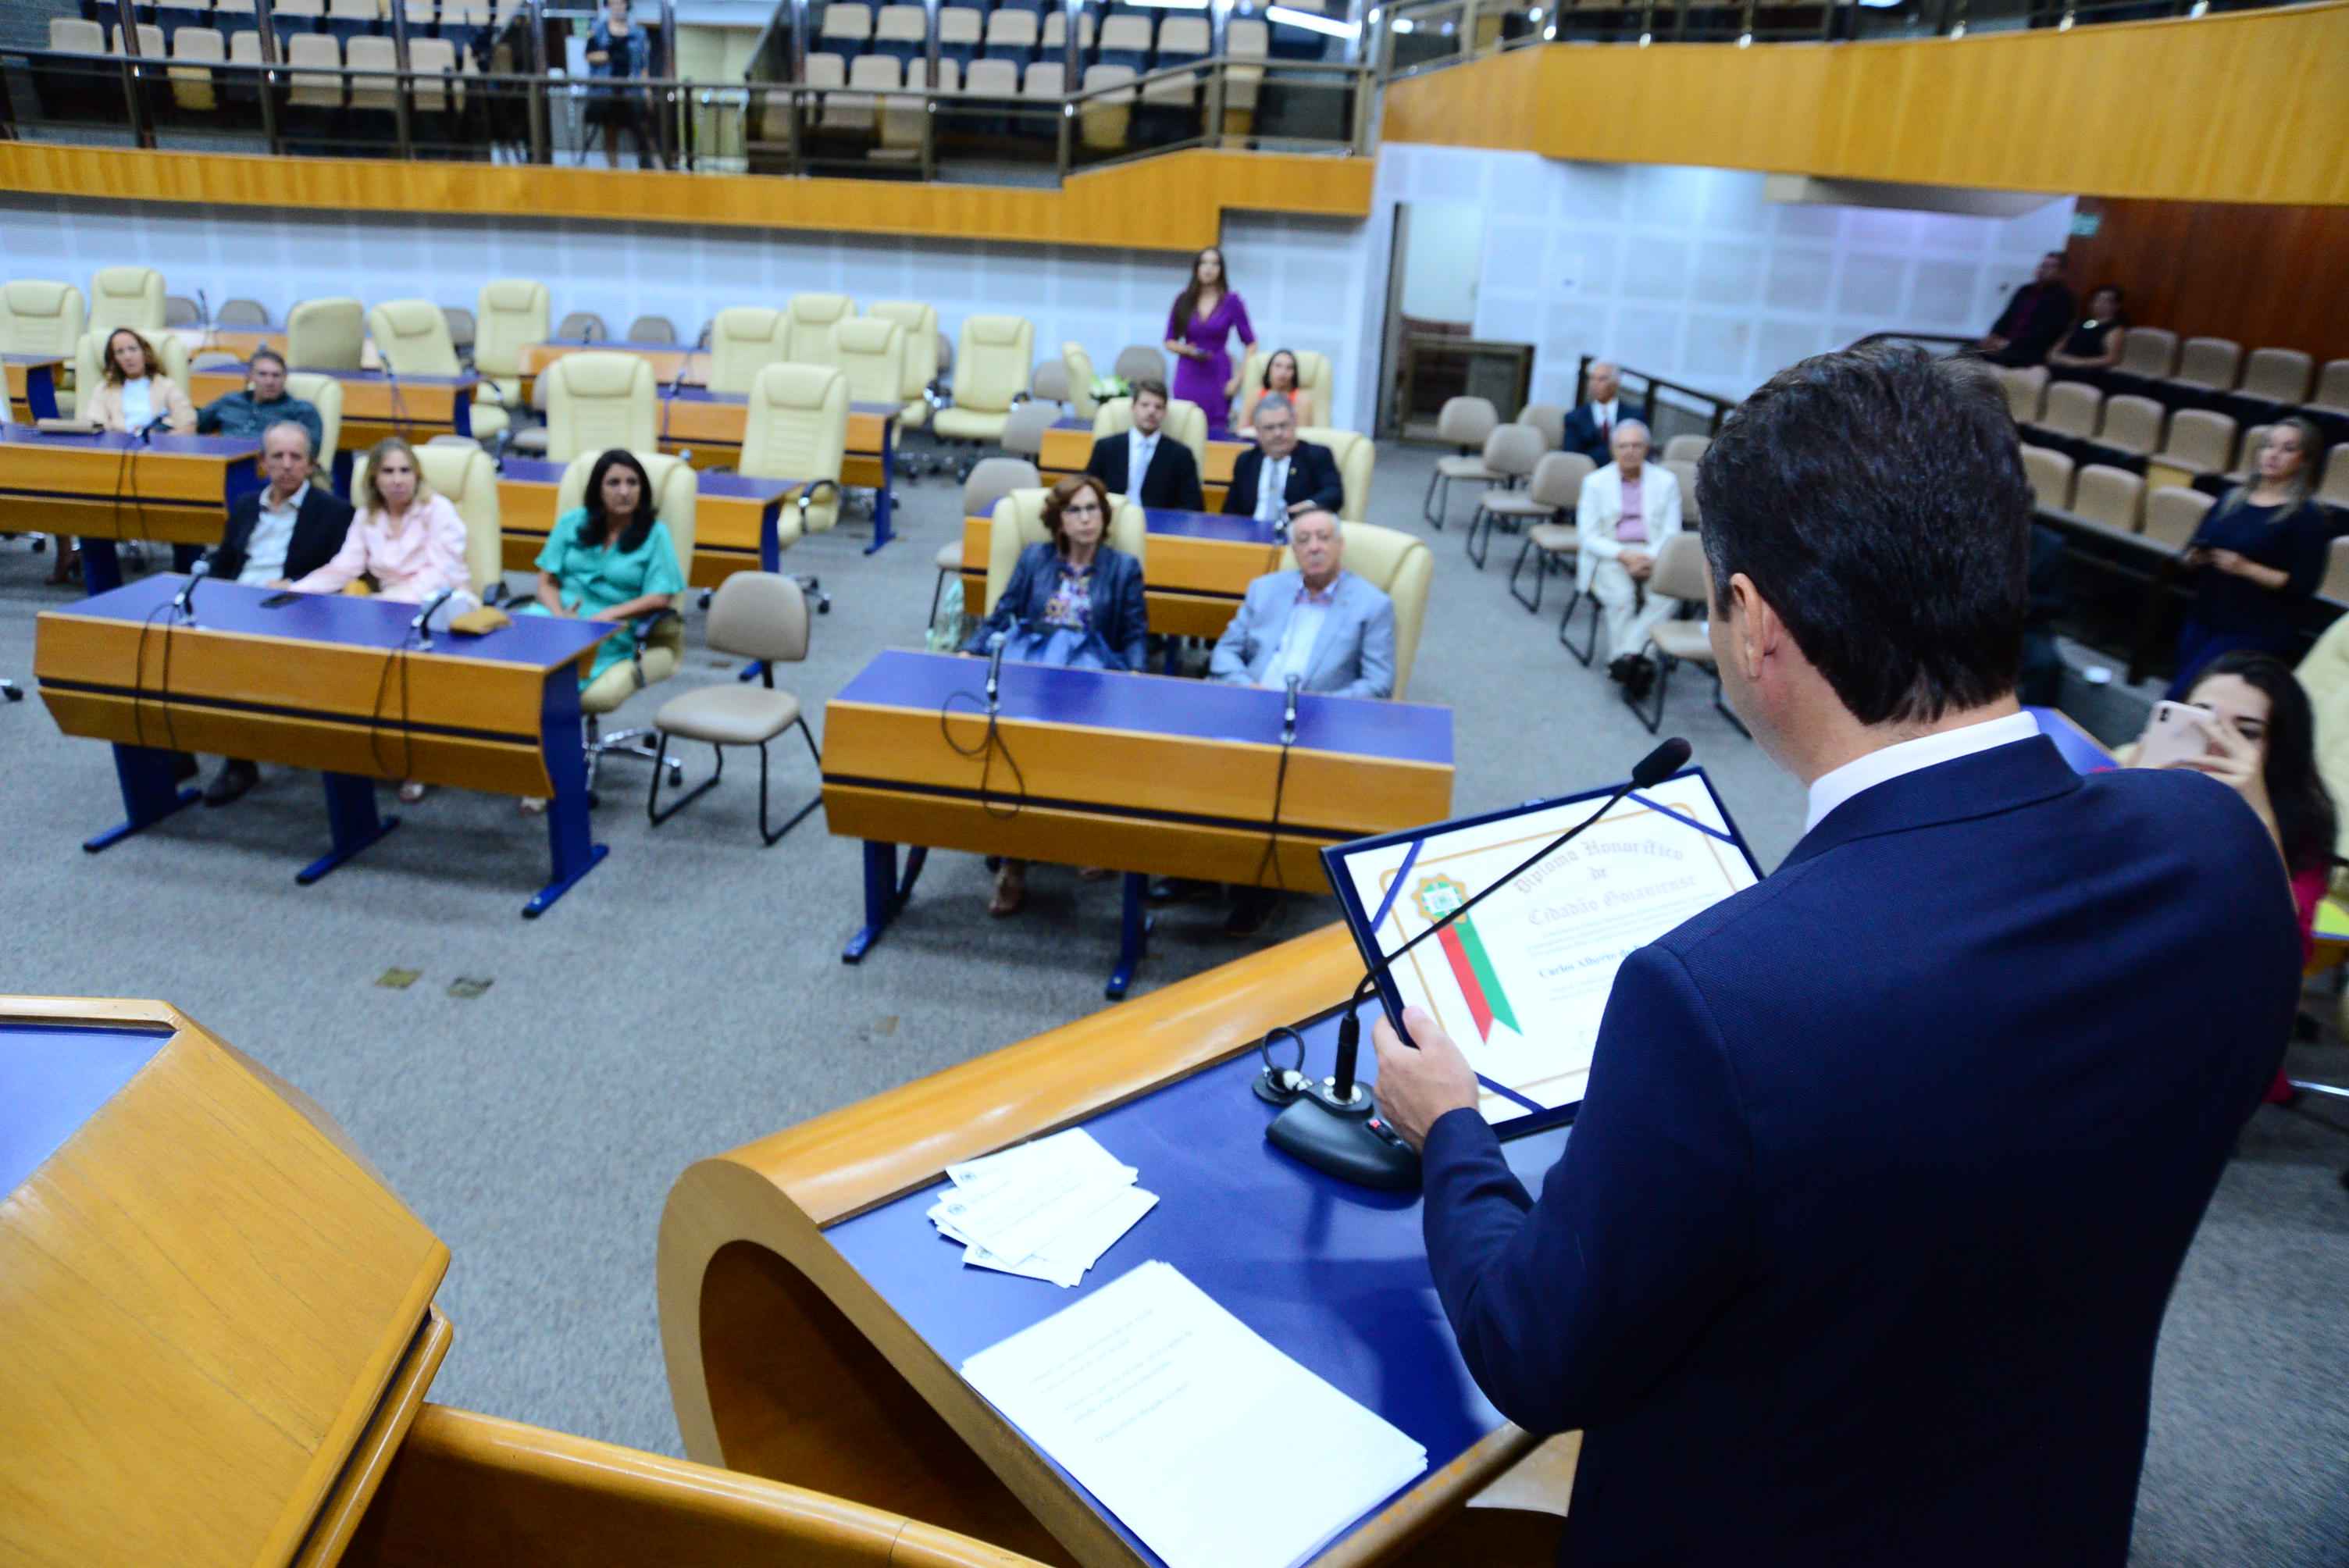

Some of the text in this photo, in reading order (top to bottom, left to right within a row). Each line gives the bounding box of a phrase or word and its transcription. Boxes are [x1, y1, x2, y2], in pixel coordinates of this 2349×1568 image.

[1513, 849, 1580, 894] Diploma
[1588, 867, 1609, 880] de
[1528, 898, 1599, 925] Cidadão
[1604, 875, 1697, 907] Goianiense
[1538, 964, 1575, 978] Carlos
[1578, 953, 1616, 968] Alberto
